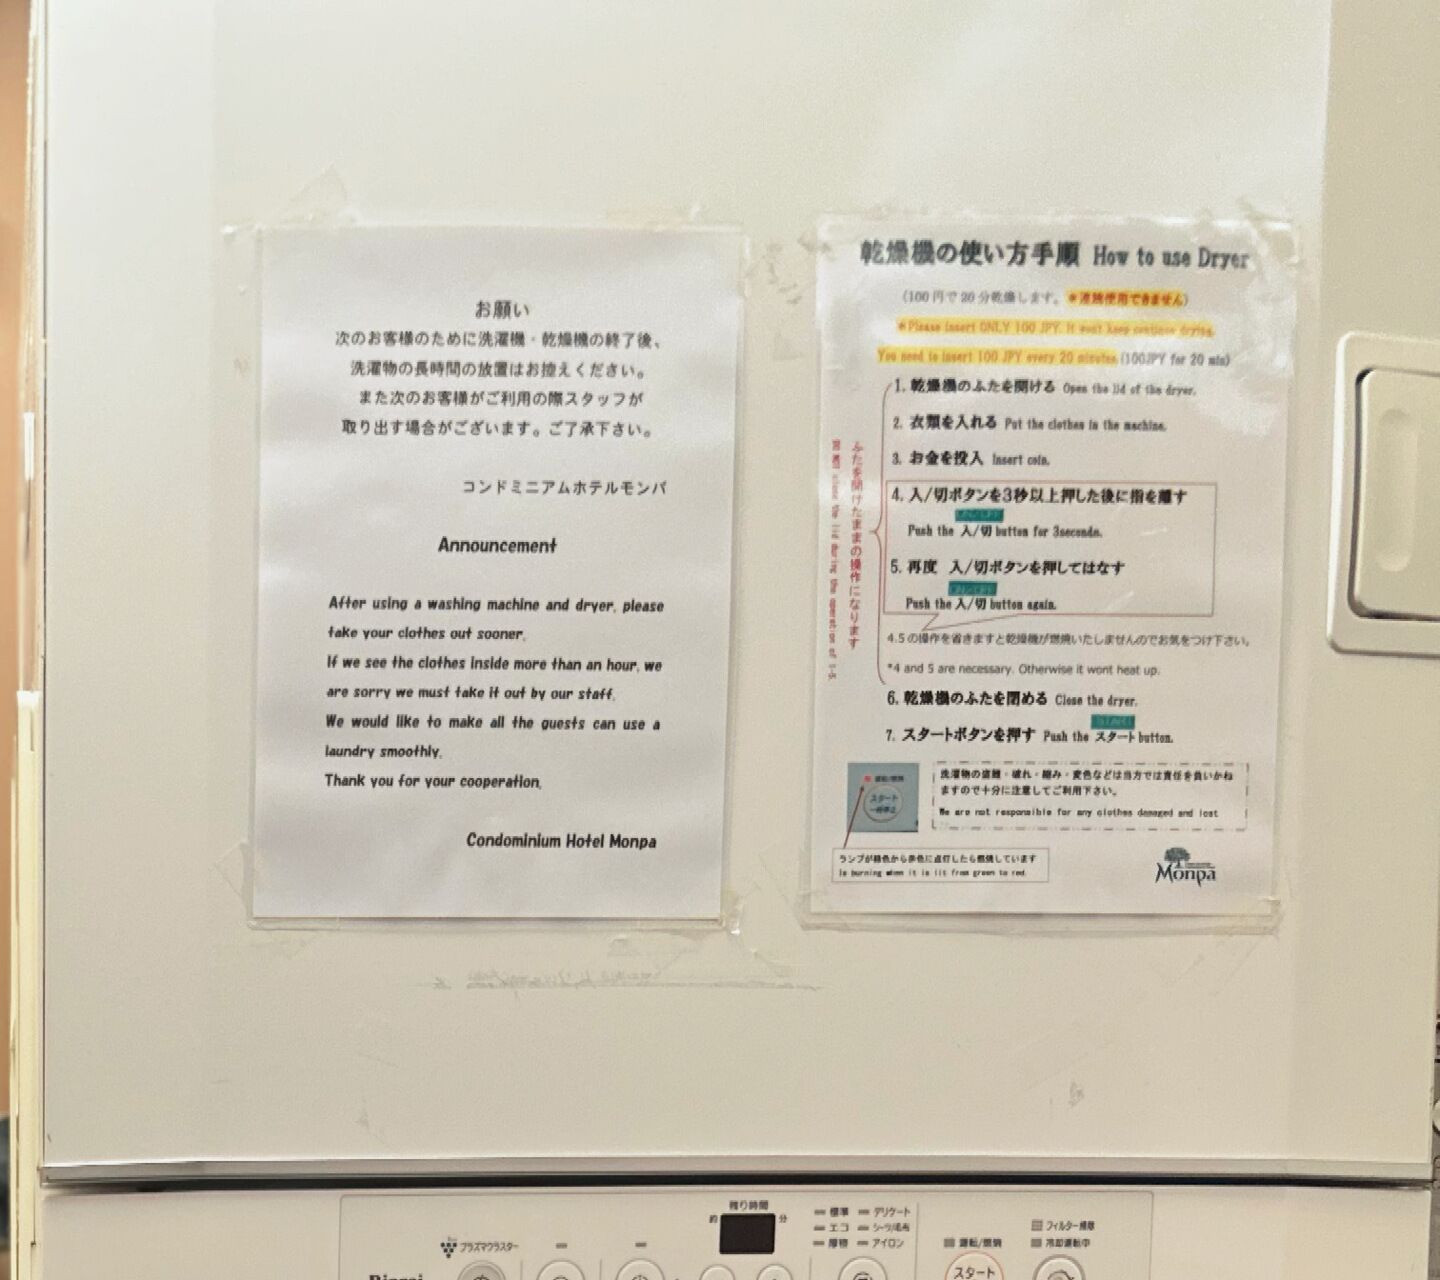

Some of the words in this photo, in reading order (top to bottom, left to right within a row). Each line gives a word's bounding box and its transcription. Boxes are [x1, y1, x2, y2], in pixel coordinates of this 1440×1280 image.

[860, 237, 1081, 269] 乾燥機の使い方手順
[1092, 243, 1130, 267] How
[1136, 245, 1155, 268] to
[1162, 250, 1192, 268] use
[1197, 245, 1250, 272] Dryer
[475, 299, 530, 320] お願い
[350, 359, 644, 380] 洗濯物の長時間の放置はお控えください。
[895, 378, 906, 394] 1.
[910, 376, 1056, 395] 乾燥機のふたを開ける
[359, 390, 644, 408] また次のお客様がご利用の際スタッフが
[341, 418, 651, 438] 取り出す場合がございます。ご了承下さい。
[893, 415, 903, 431] 2.
[909, 412, 998, 432] 衣類を入れる
[892, 452, 902, 467] 3.
[909, 449, 984, 467] お金を投入
[992, 452, 1023, 466] Insert
[1027, 453, 1050, 467] coin.
[891, 486, 904, 503] 4.
[437, 535, 558, 554] Announcement
[890, 558, 902, 574] 5.
[907, 558, 938, 575] 再度
[949, 559, 1126, 576] 入/切ボタンを押してはなす
[328, 595, 367, 611] After
[372, 595, 408, 612] using
[413, 598, 422, 611] a
[427, 595, 482, 614] washing
[486, 596, 540, 612] machine
[545, 597, 570, 612] and
[575, 596, 616, 614] dryer,
[622, 597, 665, 616] please
[327, 625, 359, 639] take
[362, 628, 394, 641] your
[397, 625, 446, 640] clothes
[449, 626, 473, 641] out
[476, 629, 524, 641] sooner.
[326, 654, 338, 670] If
[342, 657, 361, 670] we
[364, 657, 388, 670] see
[391, 654, 414, 669] the
[417, 654, 466, 671] clothes
[470, 654, 510, 671] inside
[513, 658, 547, 672] more
[551, 656, 582, 672] than
[585, 660, 603, 672] an
[606, 656, 640, 673] hour,
[644, 661, 663, 673] we
[903, 662, 924, 675] and
[927, 662, 935, 675] 5
[937, 664, 956, 675] are
[958, 664, 1012, 677] necessary.
[1018, 662, 1074, 677] Otherwise
[1076, 663, 1084, 676] it
[1086, 664, 1113, 677] wont
[1116, 664, 1141, 677] heat
[1143, 665, 1160, 679] up.
[887, 689, 899, 707] 6.
[903, 689, 1048, 707] 乾燥機のふたを閉める
[1055, 694, 1083, 707] Close
[1086, 693, 1104, 707] the
[1107, 694, 1136, 708] dryer.
[885, 728, 895, 743] 7.
[901, 725, 1036, 745] スタートボタンを押す
[324, 772, 366, 788] Thank
[370, 776, 394, 790] you
[397, 772, 421, 788] for
[424, 776, 456, 790] your
[459, 773, 542, 791] cooperation.
[466, 831, 562, 849] Condominium
[565, 833, 605, 849] Hotel
[609, 833, 657, 851] Monpa
[1155, 862, 1216, 888] Monpa
[728, 1199, 769, 1211] 残り時間
[829, 1207, 849, 1217] 標準
[873, 1206, 911, 1218] デリケート
[829, 1222, 850, 1233] エコ
[459, 1240, 519, 1253] プラズマクラスター
[871, 1238, 905, 1249] アイロン
[953, 1266, 996, 1280] スタート
